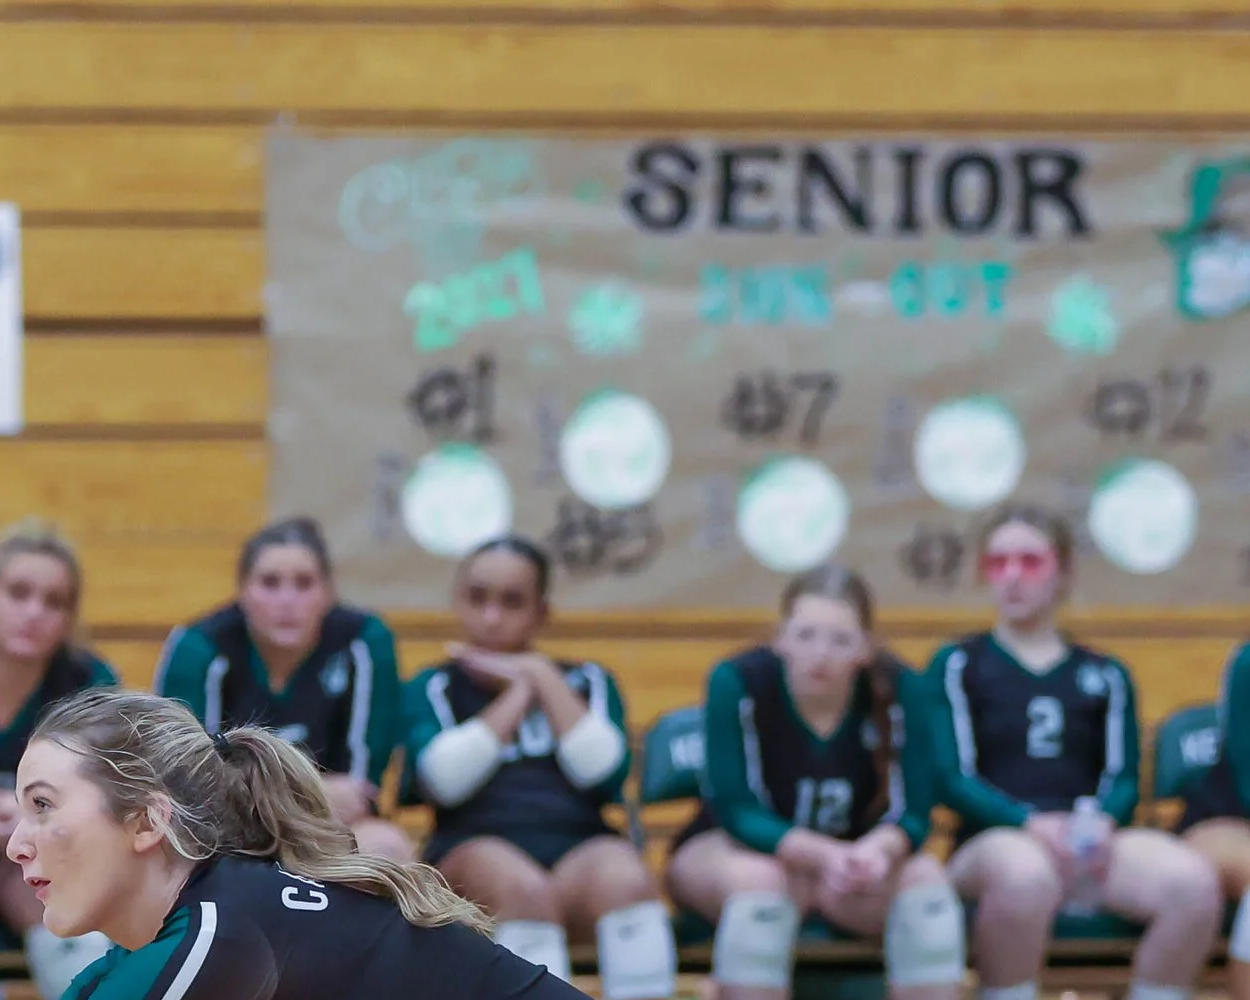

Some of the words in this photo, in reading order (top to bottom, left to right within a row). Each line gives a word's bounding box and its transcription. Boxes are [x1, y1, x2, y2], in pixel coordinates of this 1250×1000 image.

[622, 142, 1093, 239] SENIOR
[1025, 696, 1065, 758] 2
[796, 776, 853, 836] 12
[276, 861, 329, 912] C
